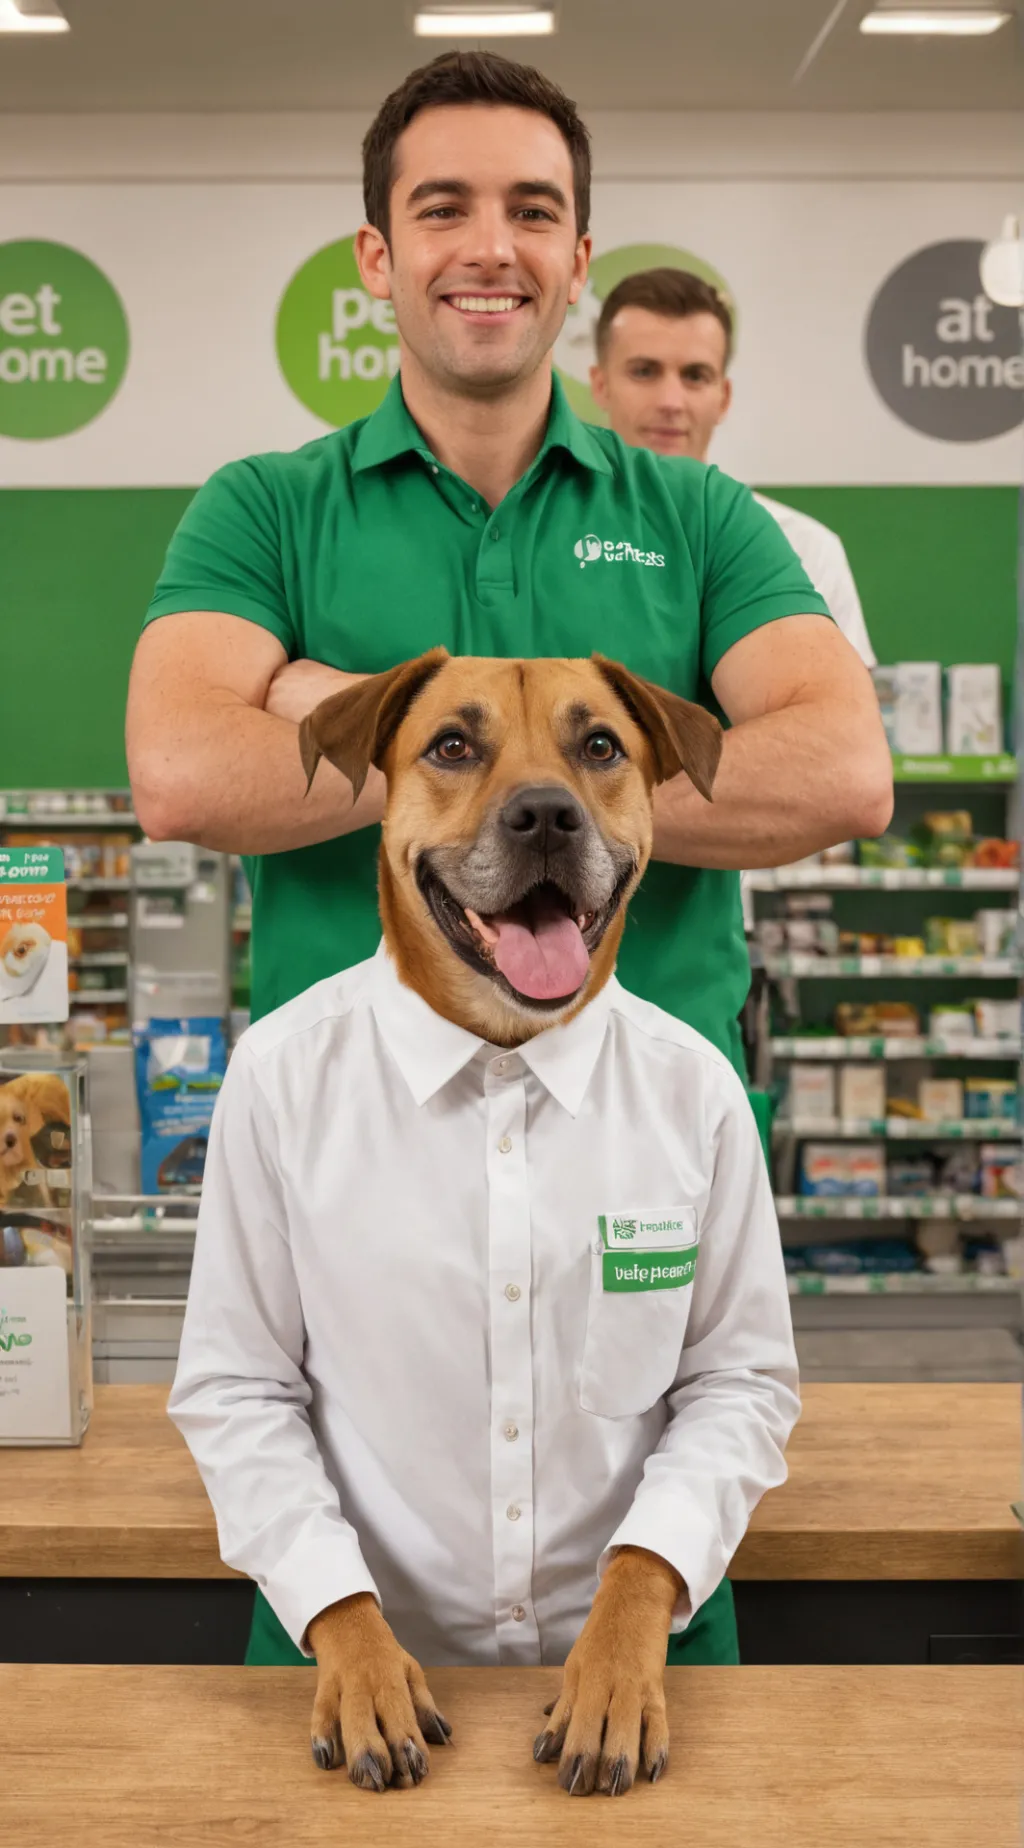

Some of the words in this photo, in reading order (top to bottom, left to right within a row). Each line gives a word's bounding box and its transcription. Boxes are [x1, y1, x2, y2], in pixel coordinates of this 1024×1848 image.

[332, 288, 398, 341] pe
[936, 294, 995, 342] at
[902, 344, 1024, 388] home
